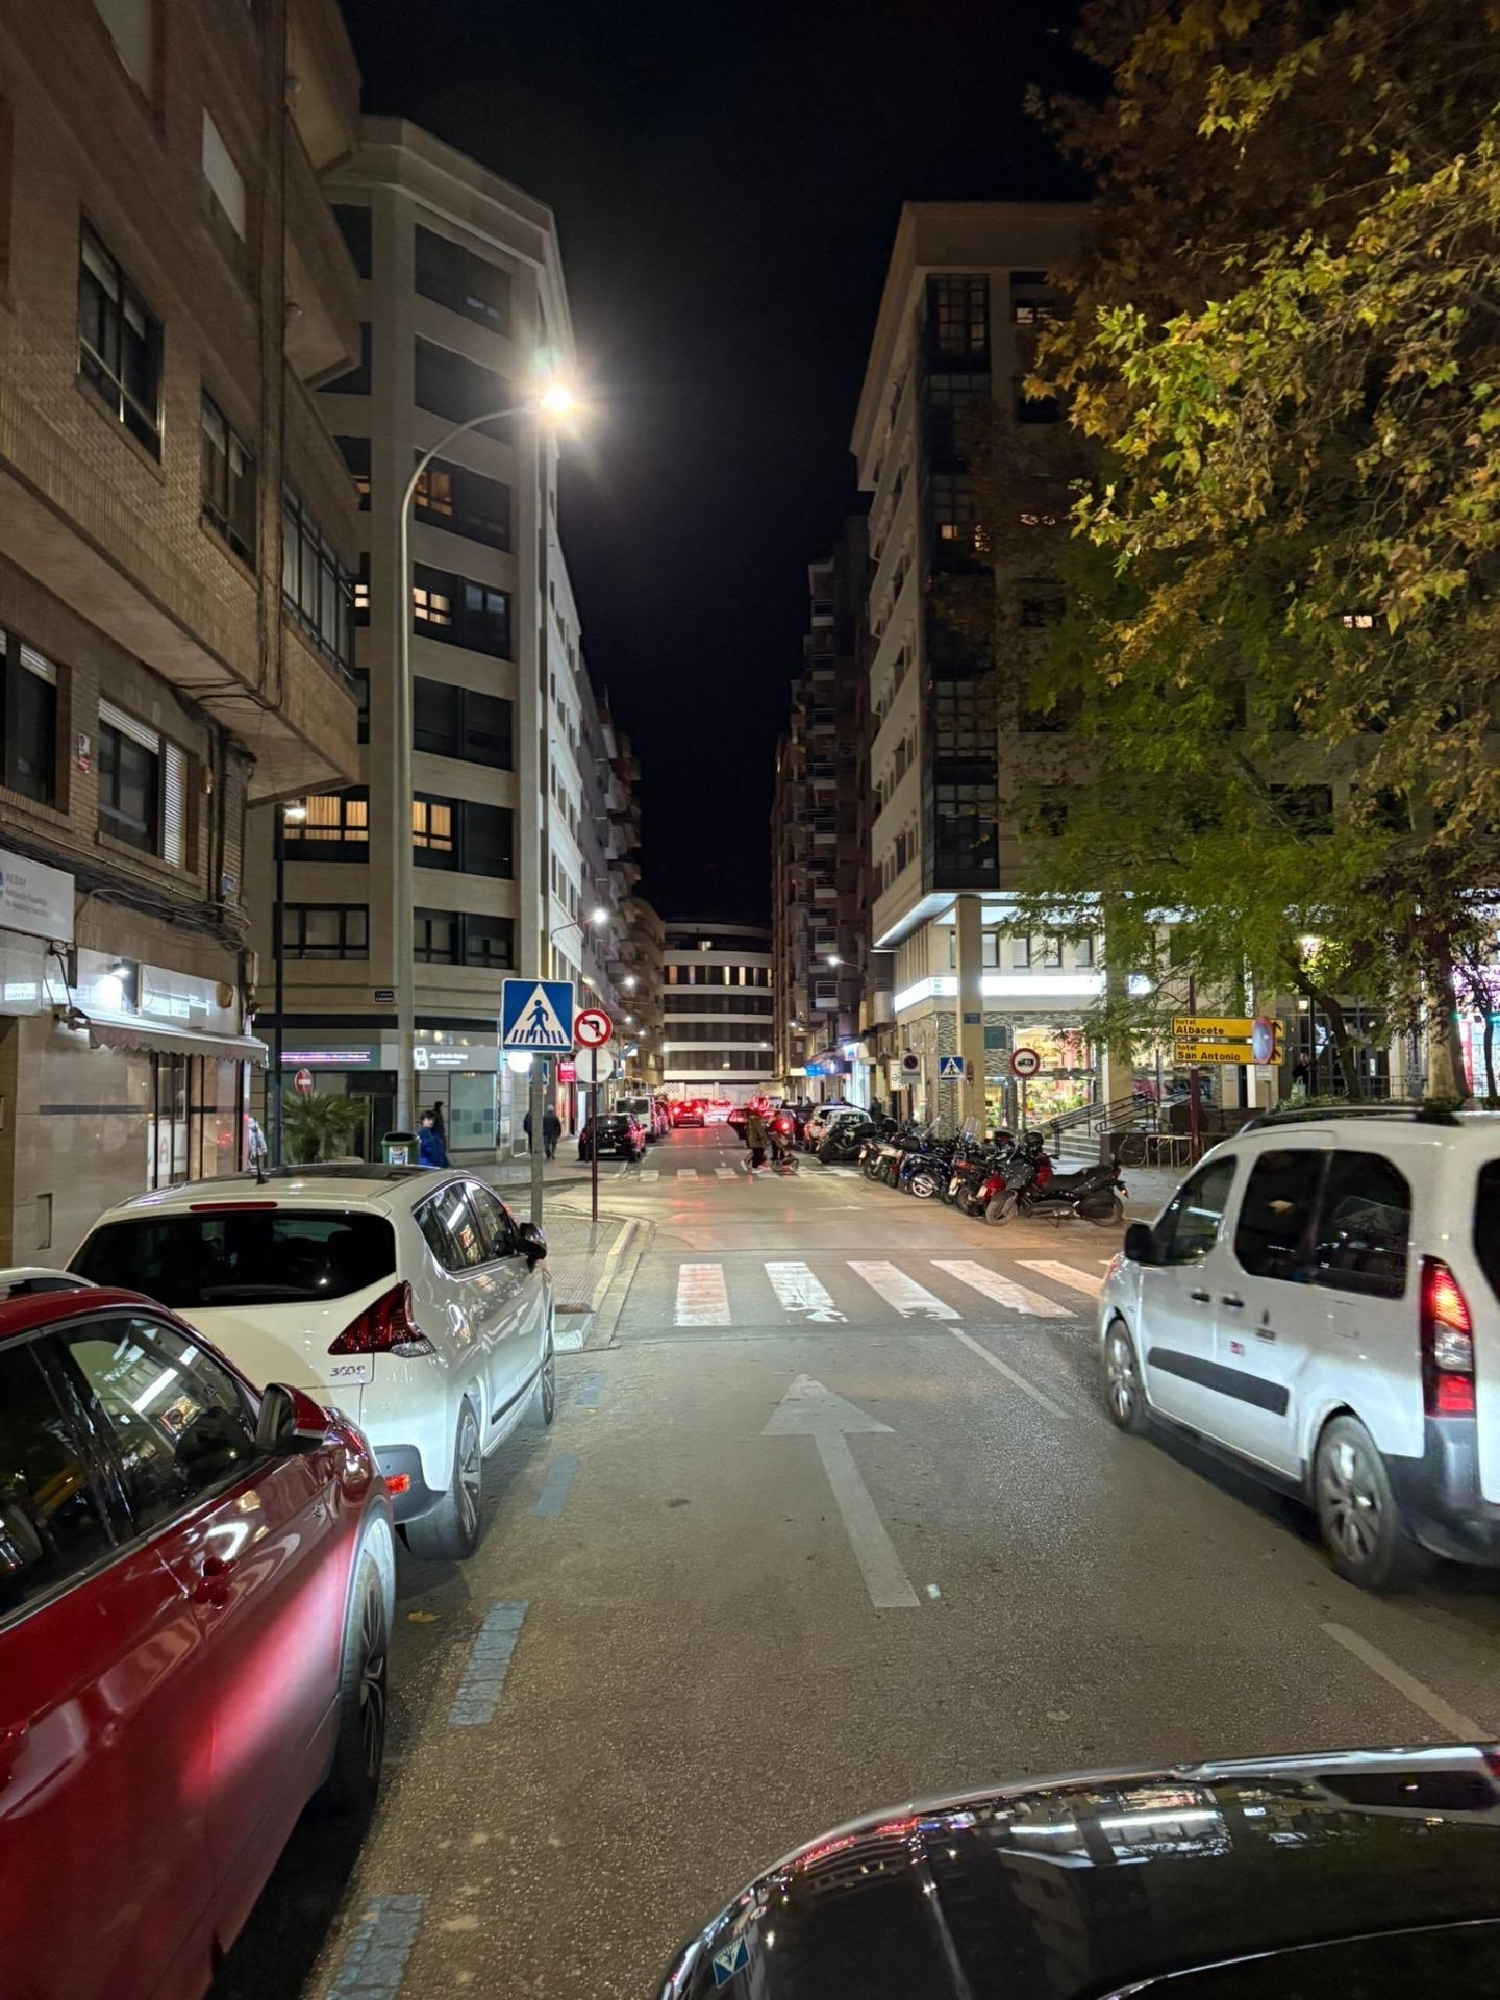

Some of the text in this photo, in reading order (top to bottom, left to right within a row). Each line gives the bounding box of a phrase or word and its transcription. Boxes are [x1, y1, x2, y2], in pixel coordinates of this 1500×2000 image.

[1176, 1025, 1225, 1035] Albacete
[1177, 1051, 1241, 1061] San Antonio
